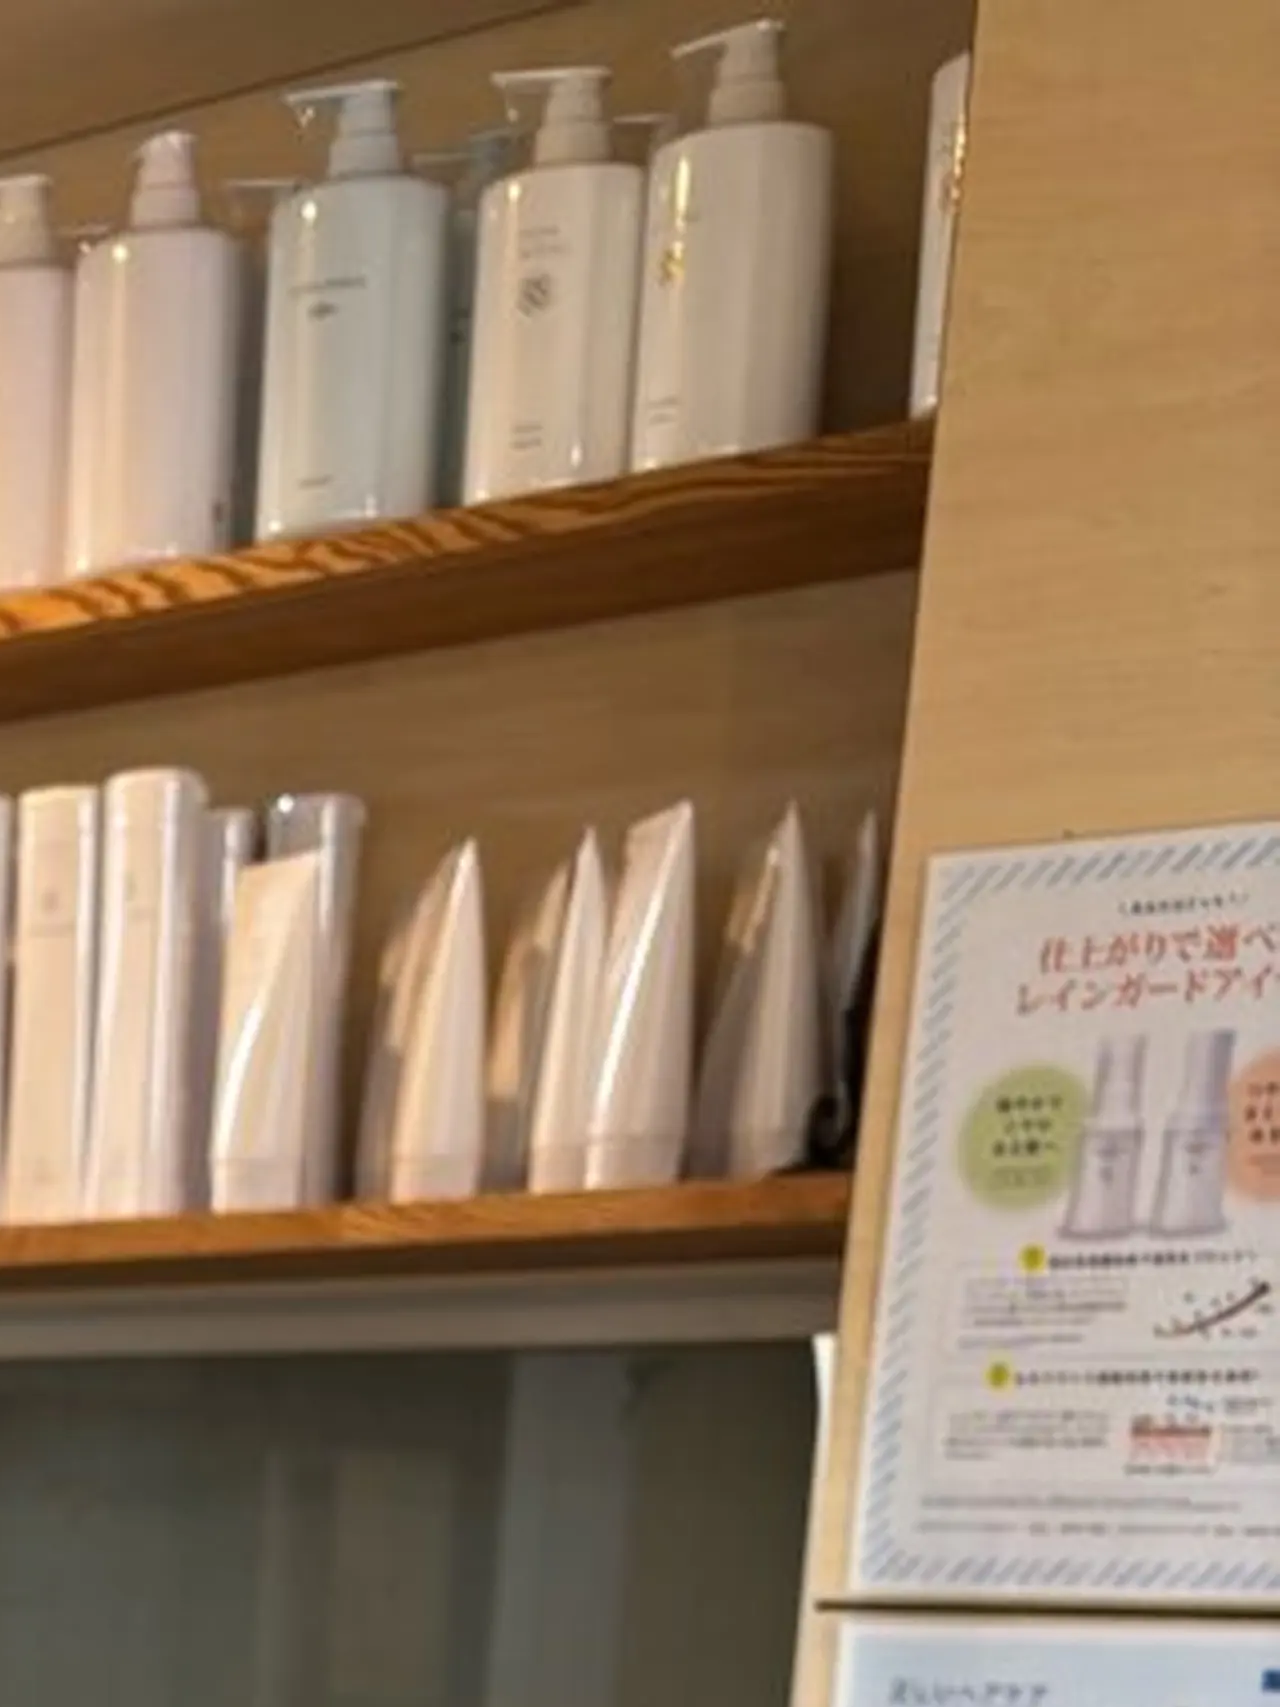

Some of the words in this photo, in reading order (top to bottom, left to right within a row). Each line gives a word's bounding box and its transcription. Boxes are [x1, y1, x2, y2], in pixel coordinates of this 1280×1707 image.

[1017, 963, 1280, 1015] レインガードアイ
